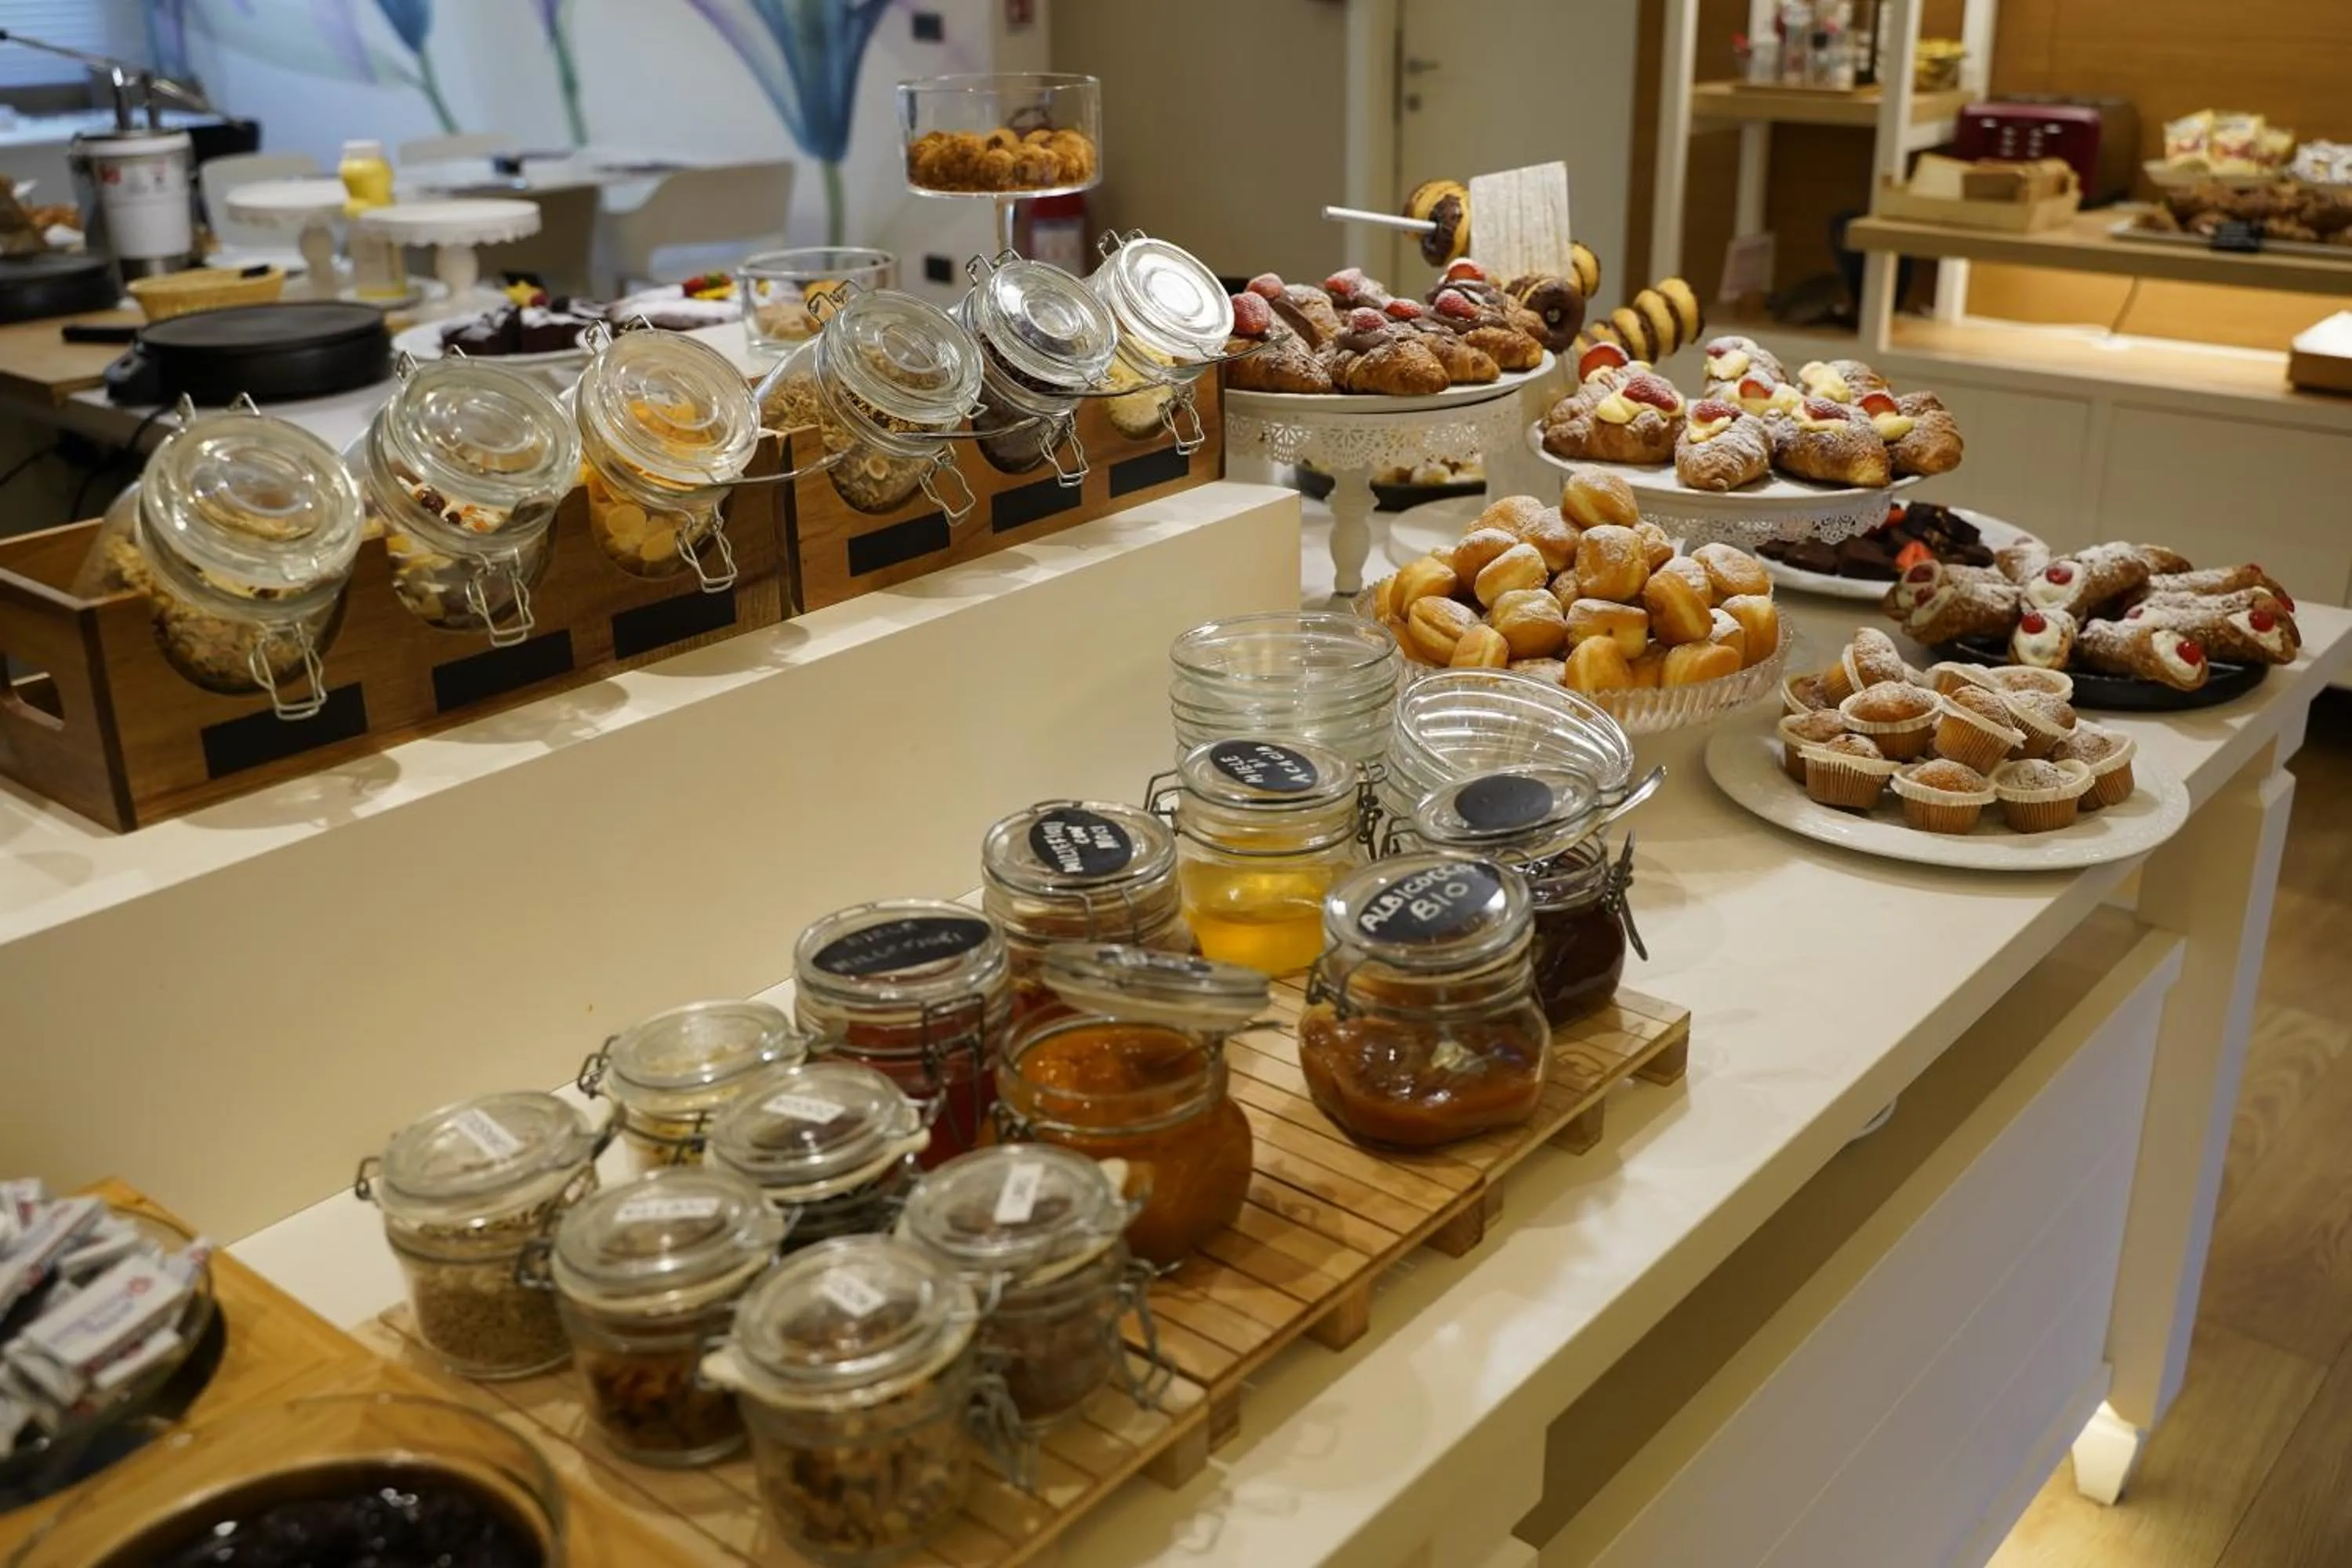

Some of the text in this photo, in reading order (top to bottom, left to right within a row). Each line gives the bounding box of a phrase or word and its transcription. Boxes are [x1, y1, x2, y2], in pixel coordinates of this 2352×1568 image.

[1220, 755, 1264, 783] MIELE
[1255, 746, 1312, 783] ACACIA
[1360, 863, 1478, 932] ALBICOCCA
[1410, 882, 1469, 922] BIO
